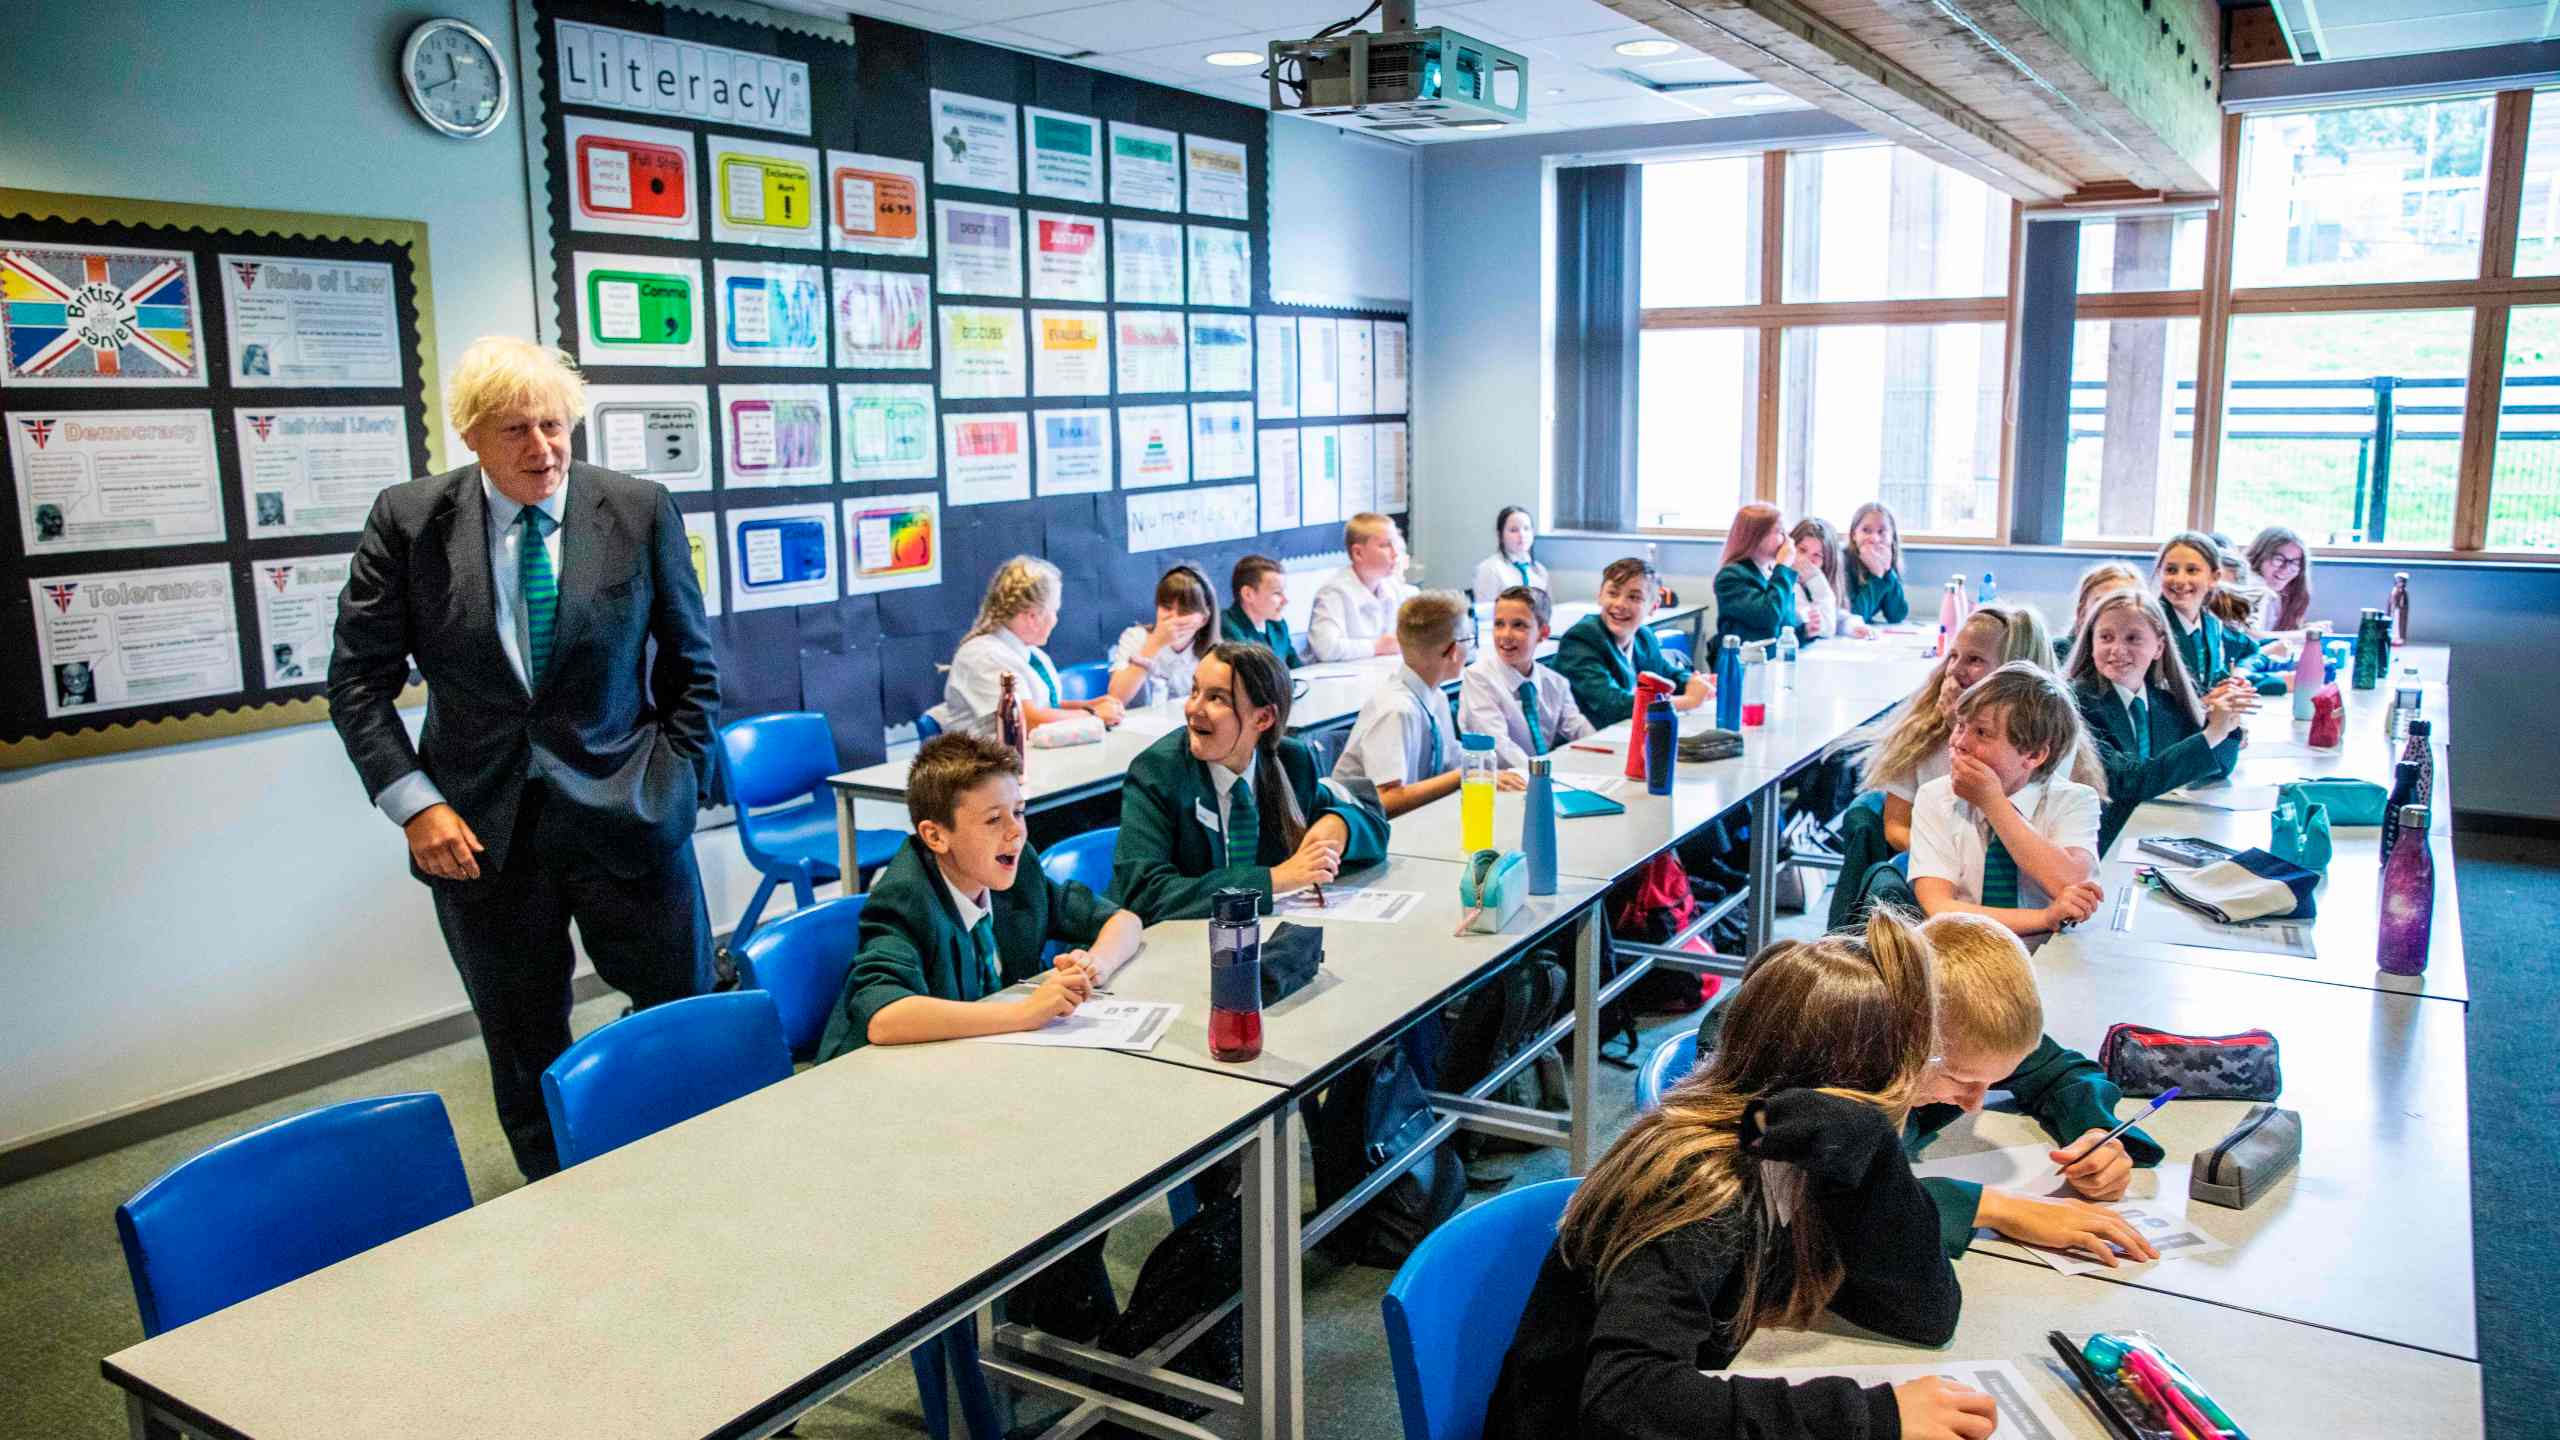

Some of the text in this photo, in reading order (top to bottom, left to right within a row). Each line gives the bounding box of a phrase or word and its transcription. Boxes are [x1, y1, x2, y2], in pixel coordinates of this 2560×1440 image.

[568, 47, 780, 118] Literacy
[264, 265, 386, 295] Rule of Law
[641, 284, 687, 299] Comma
[67, 283, 136, 351] British Values
[64, 422, 198, 445] Democracy
[83, 579, 224, 609] Tolerance
